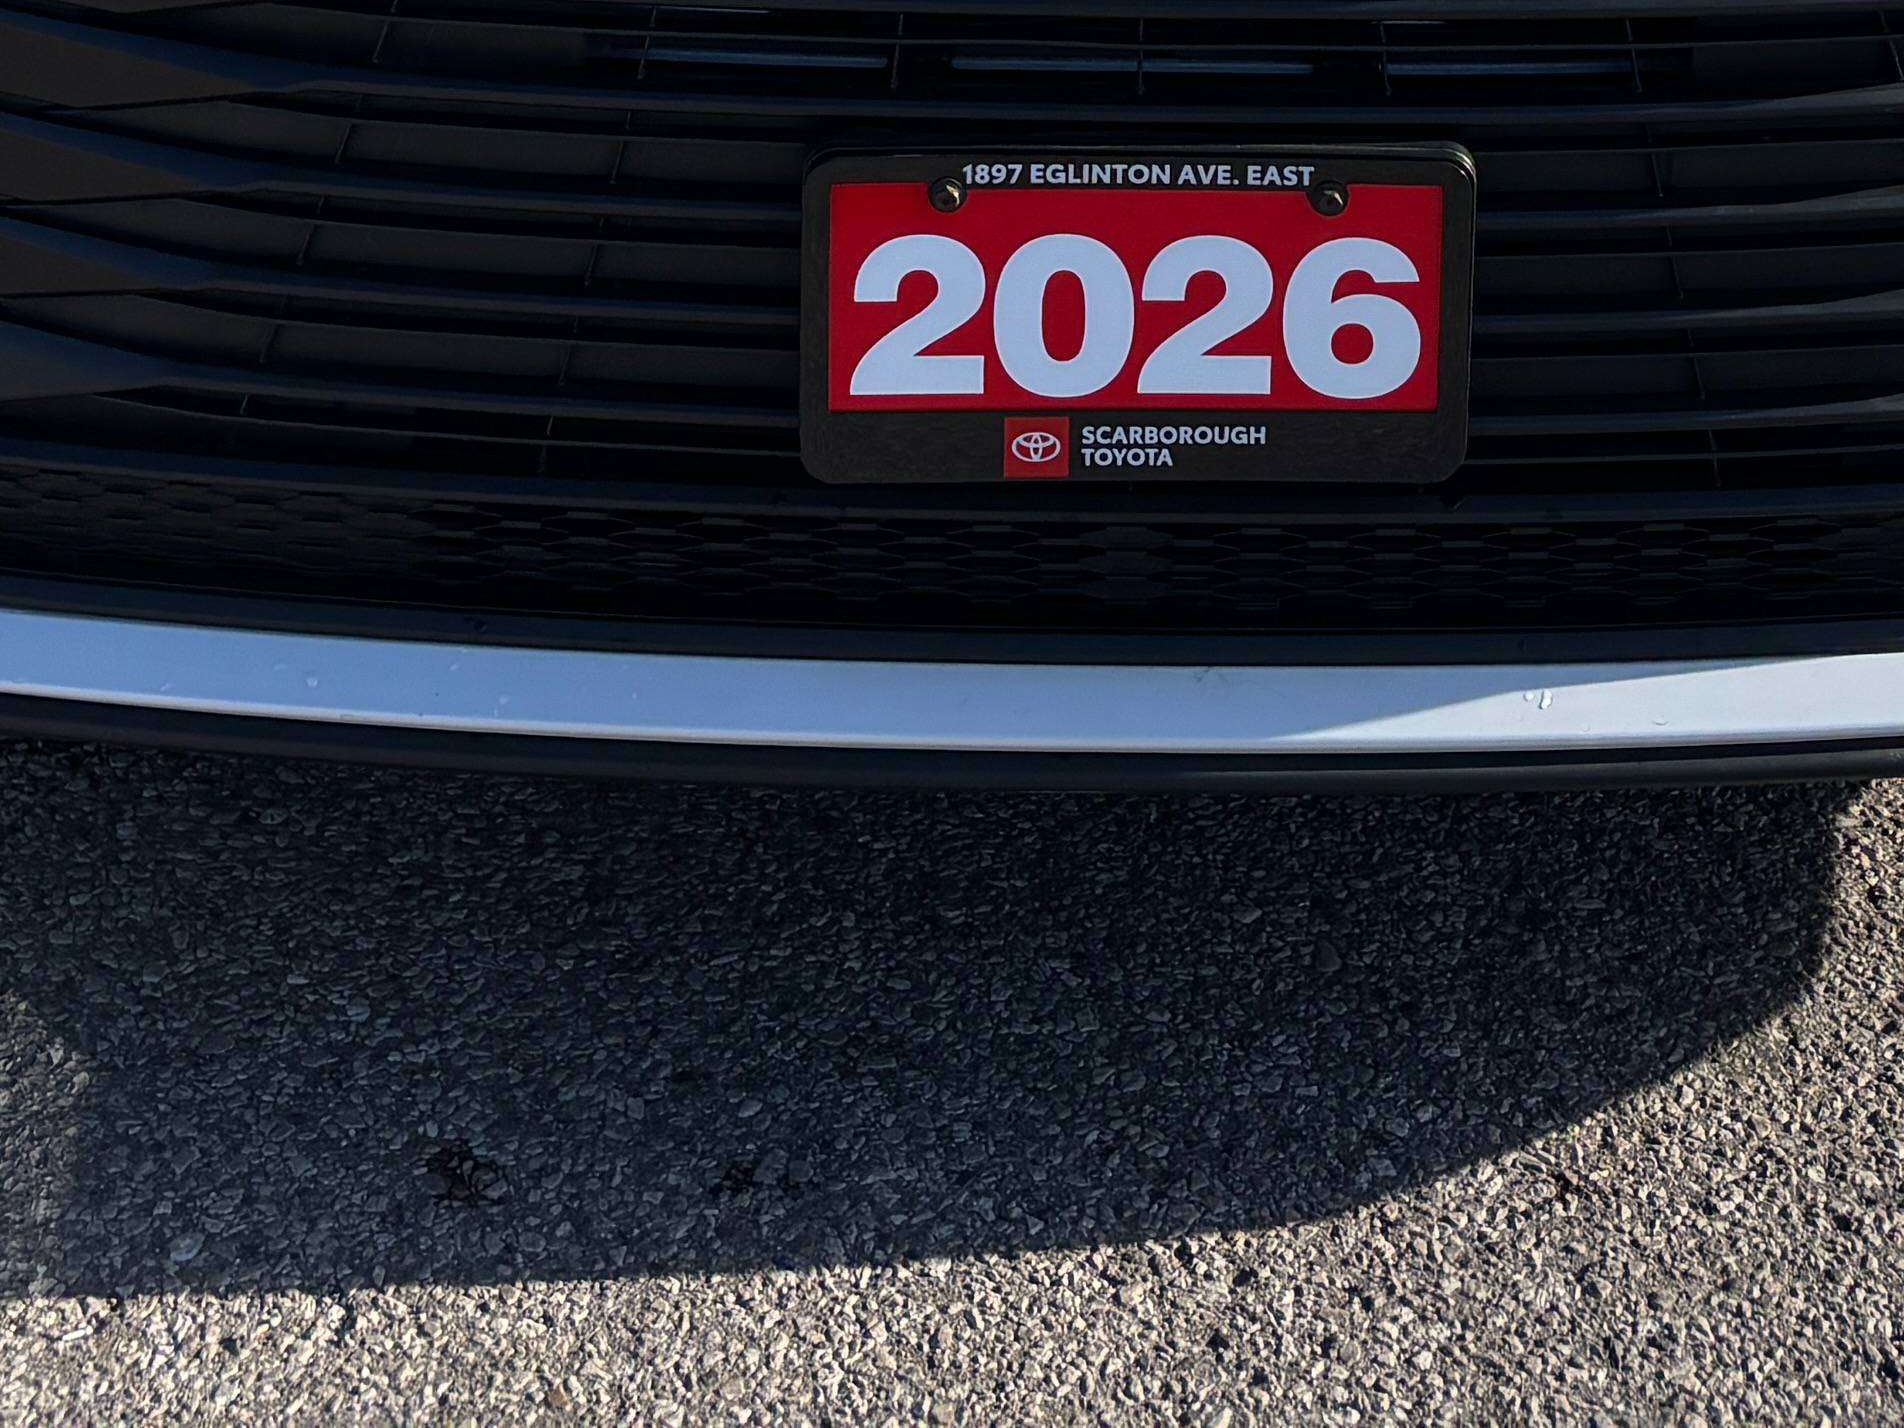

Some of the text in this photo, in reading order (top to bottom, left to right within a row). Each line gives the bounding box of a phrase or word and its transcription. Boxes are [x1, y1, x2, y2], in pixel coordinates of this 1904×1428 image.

[962, 163, 1315, 187] 1897 EGLINTON AVE. EAST
[849, 232, 1422, 399] 2026
[1081, 425, 1267, 446] SCARBOROUGH
[1081, 447, 1173, 468] TOYOTA
